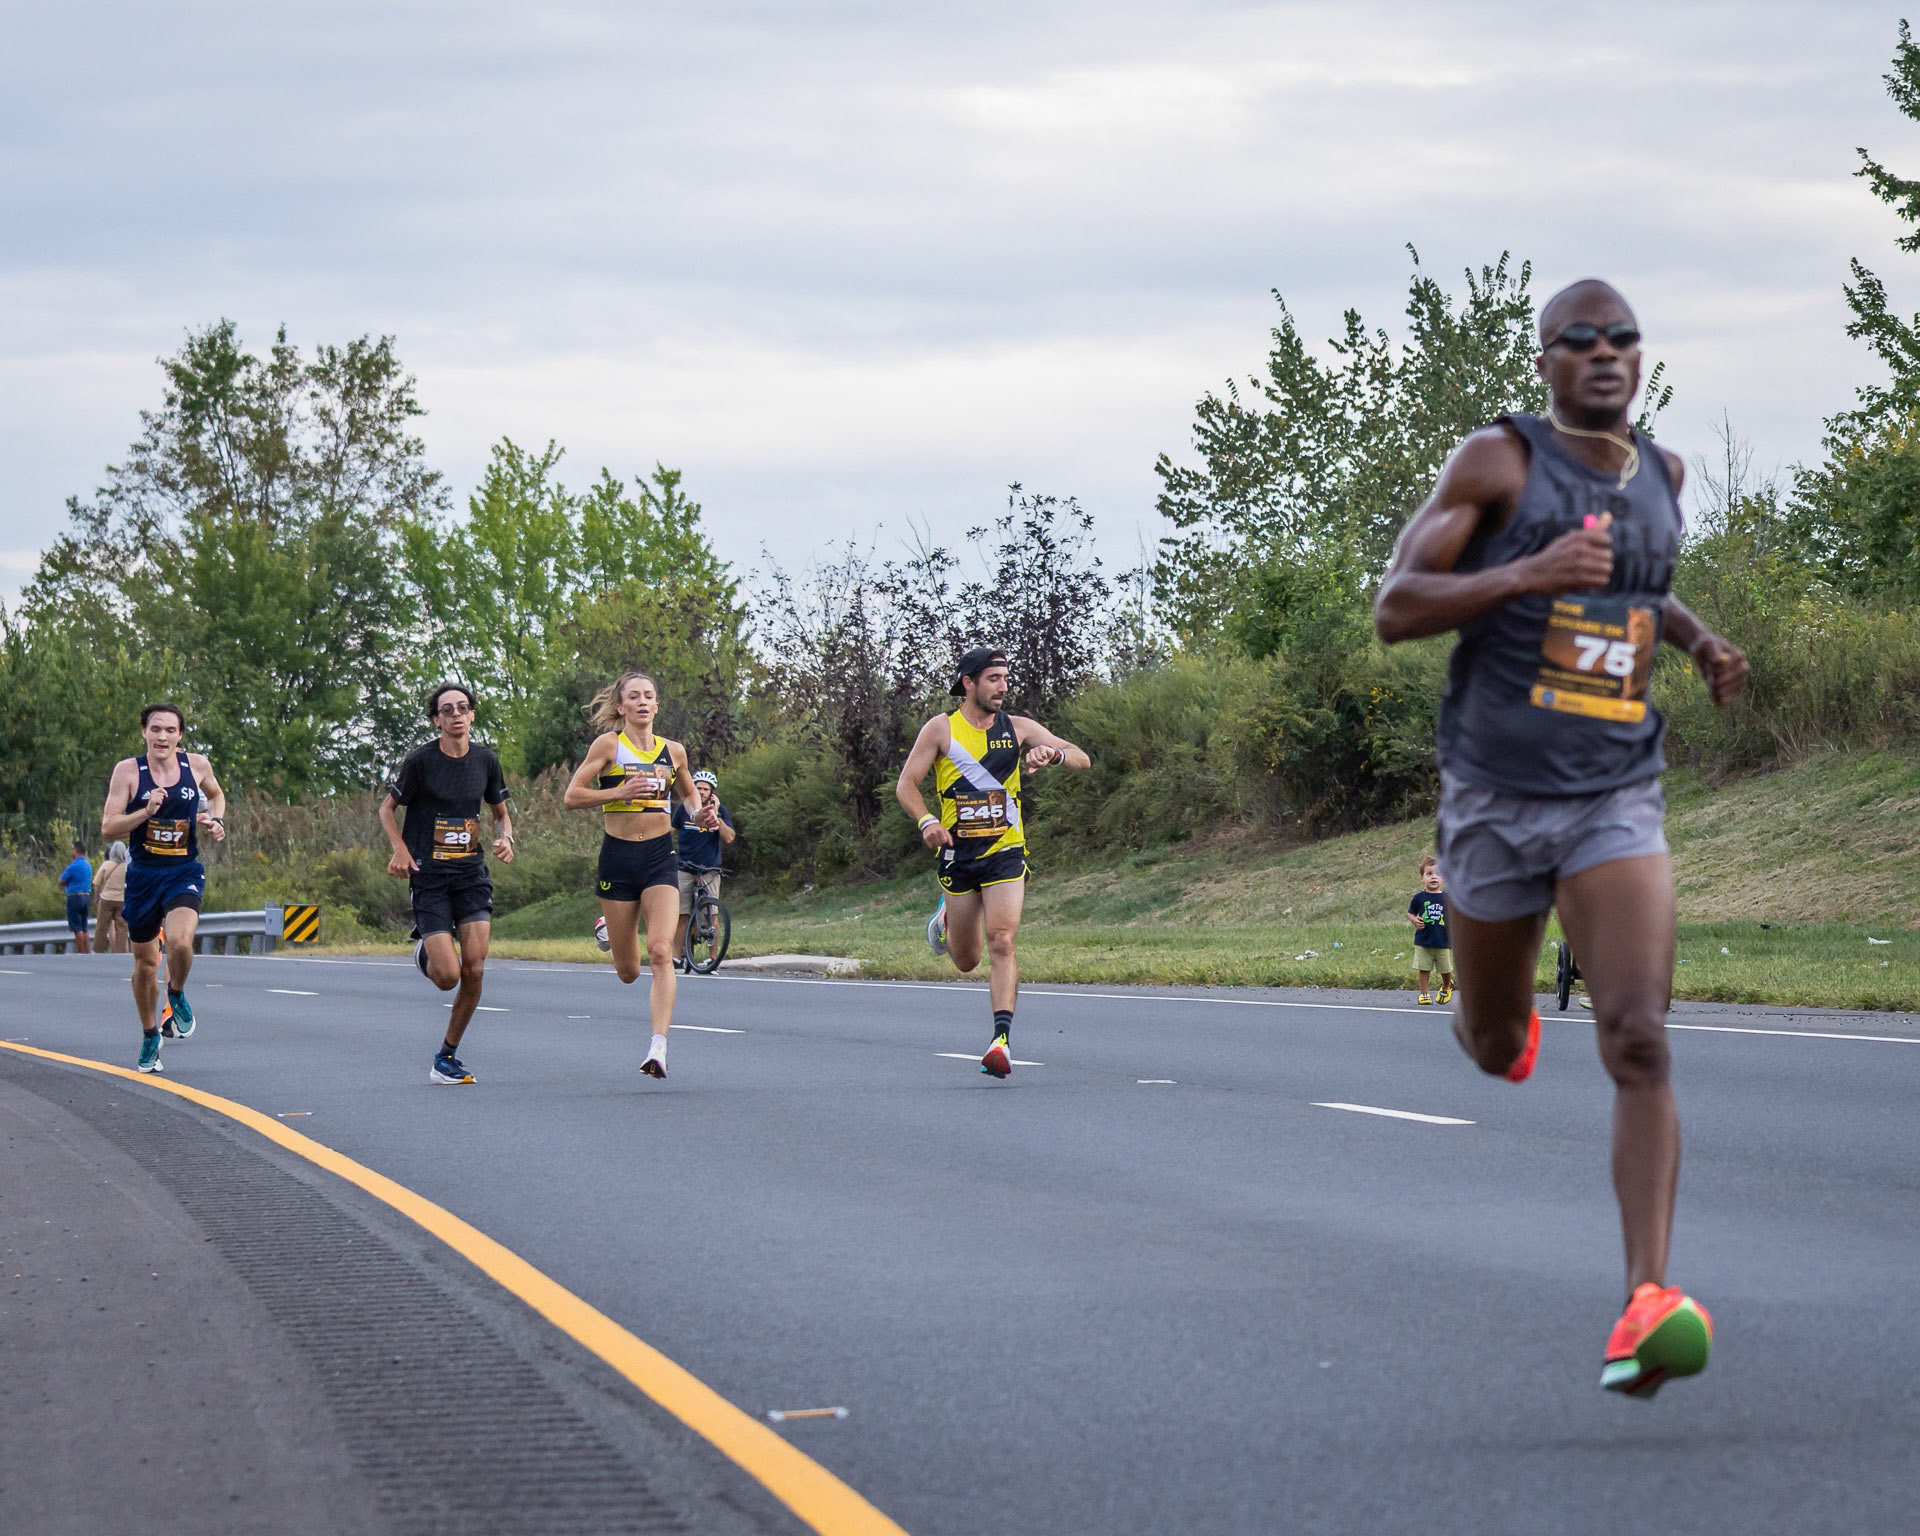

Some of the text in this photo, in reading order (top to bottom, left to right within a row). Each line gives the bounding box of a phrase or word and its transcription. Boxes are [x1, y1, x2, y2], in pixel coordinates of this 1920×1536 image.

[1573, 634, 1637, 677] 75
[989, 739, 1014, 750] GSTC
[181, 786, 195, 801] SP
[960, 804, 1004, 821] 245
[152, 830, 184, 842] 137
[444, 831, 471, 844] 29
